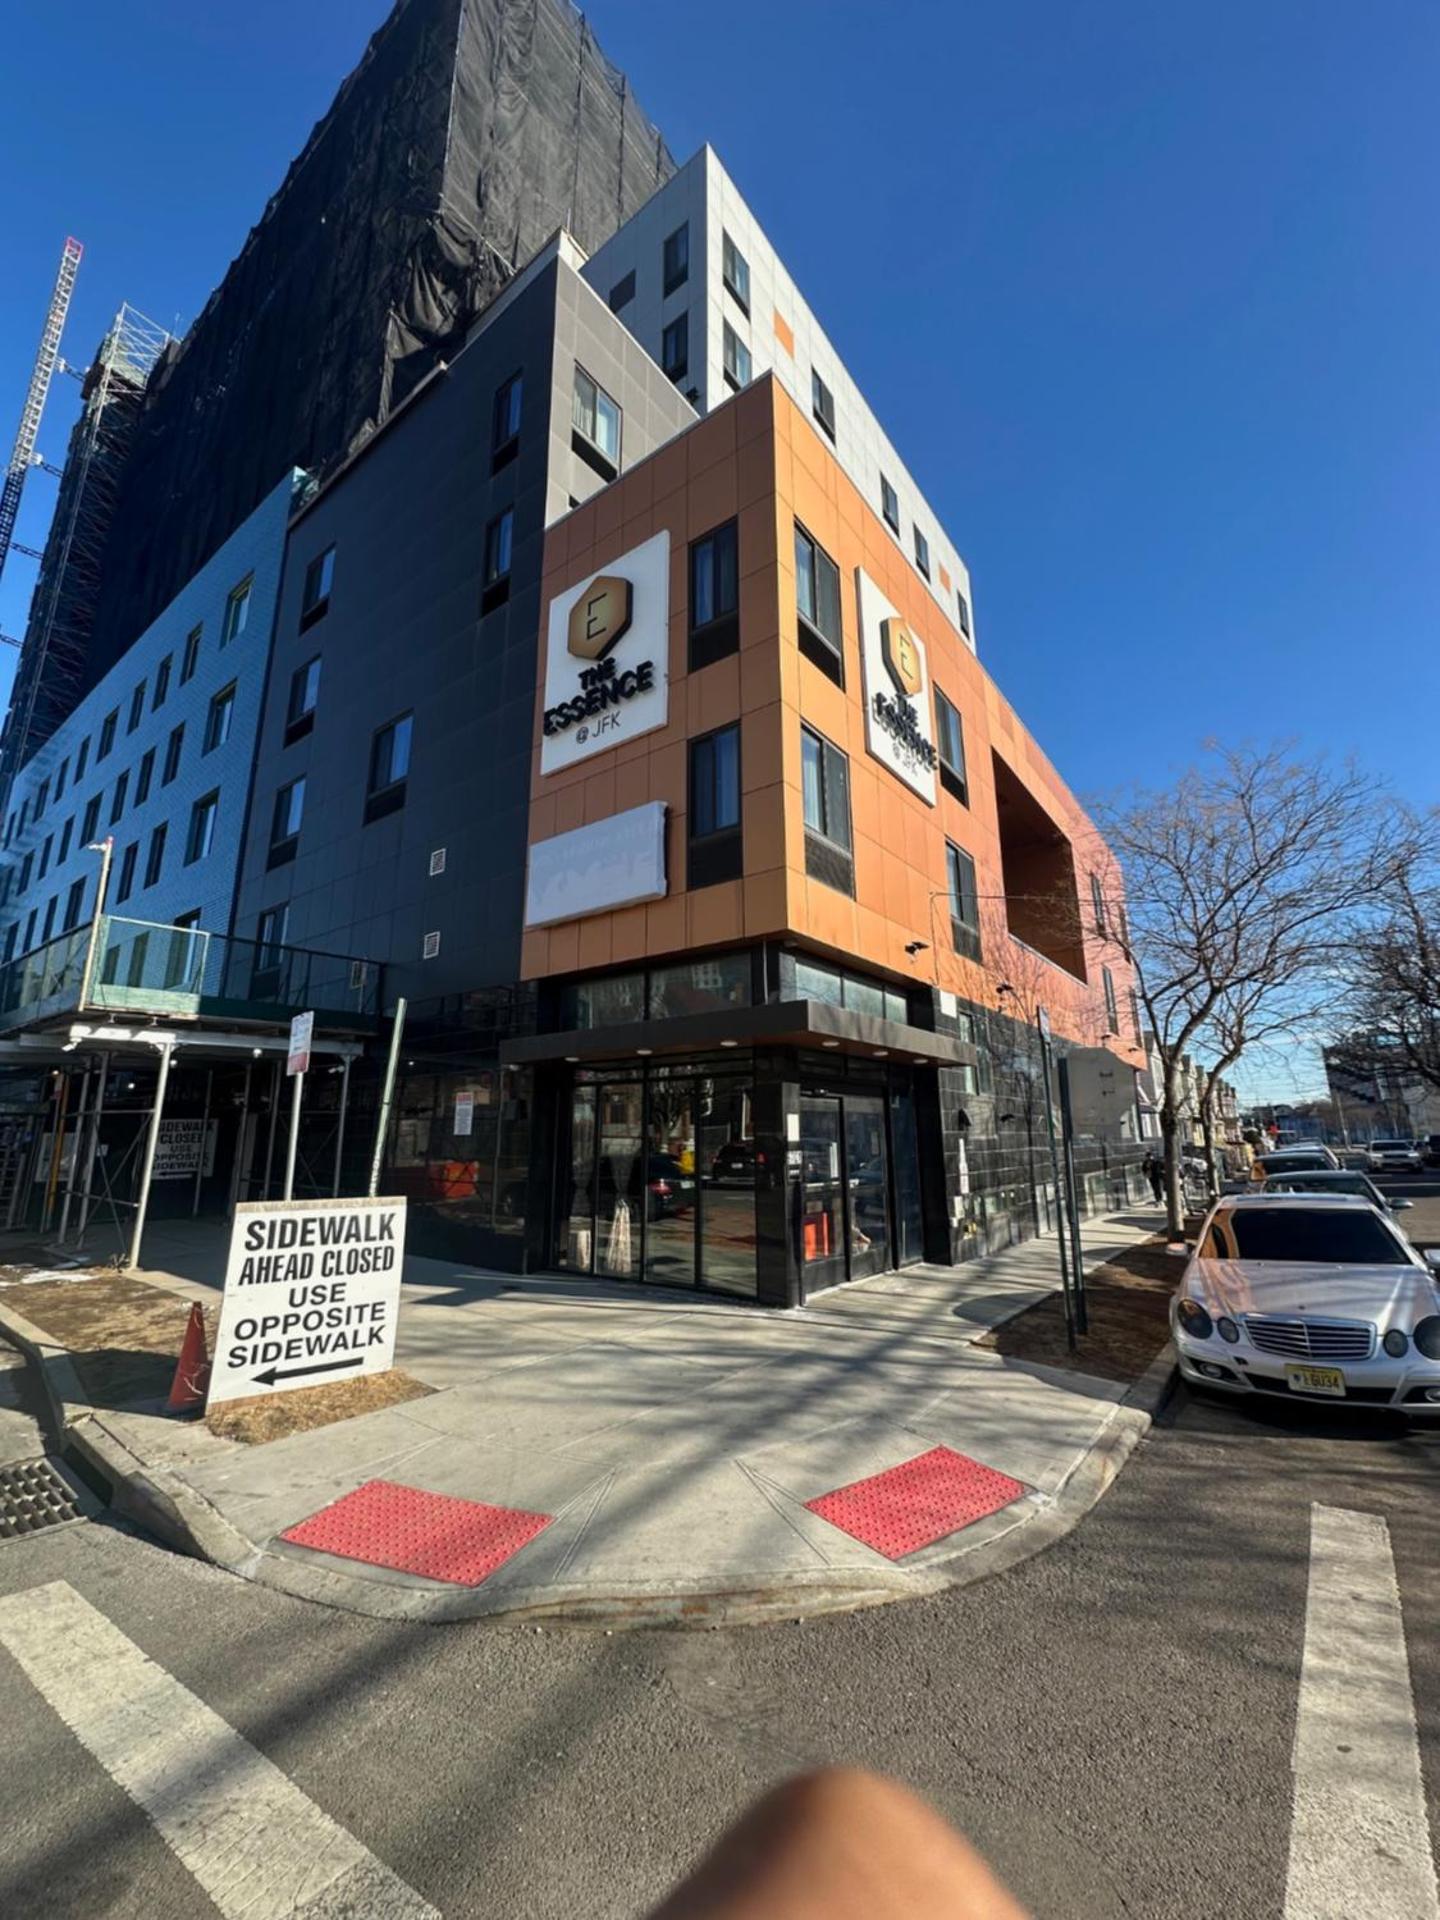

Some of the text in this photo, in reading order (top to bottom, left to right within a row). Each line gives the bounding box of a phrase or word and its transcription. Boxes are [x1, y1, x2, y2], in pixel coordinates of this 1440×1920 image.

[577, 656, 617, 690] THE
[543, 661, 654, 737] ESSENCE
[592, 710, 622, 738] JFK
[160, 1121, 213, 1132] IDEWALK
[244, 1213, 396, 1252] SIDEWALK
[238, 1246, 395, 1286] AHEAD CLOSED
[288, 1282, 347, 1308] USE
[233, 1301, 387, 1341] OPPOSITE
[227, 1325, 387, 1369] SIDEWALK
